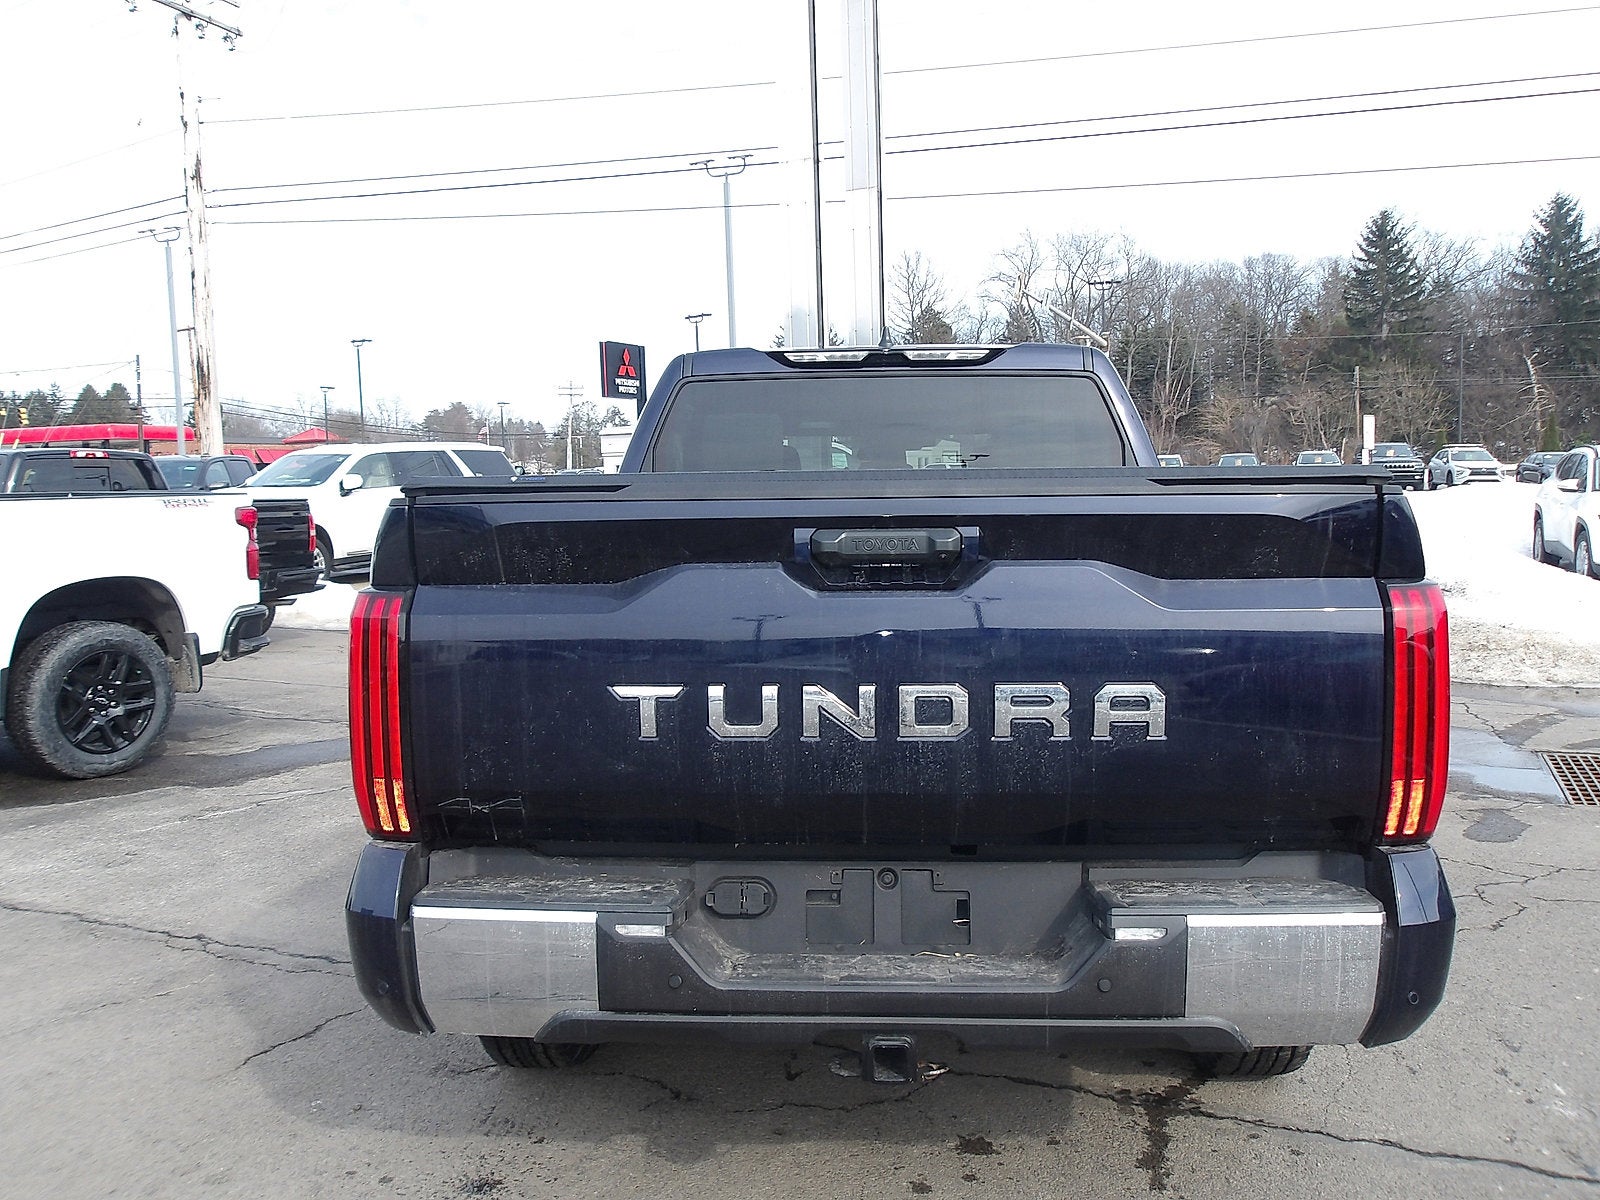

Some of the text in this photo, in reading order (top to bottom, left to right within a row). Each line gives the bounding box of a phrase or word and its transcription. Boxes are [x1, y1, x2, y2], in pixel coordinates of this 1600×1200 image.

[618, 386, 638, 395] MOTORS
[852, 538, 919, 552] TOYOTA
[607, 683, 1168, 742] TUNDRA
